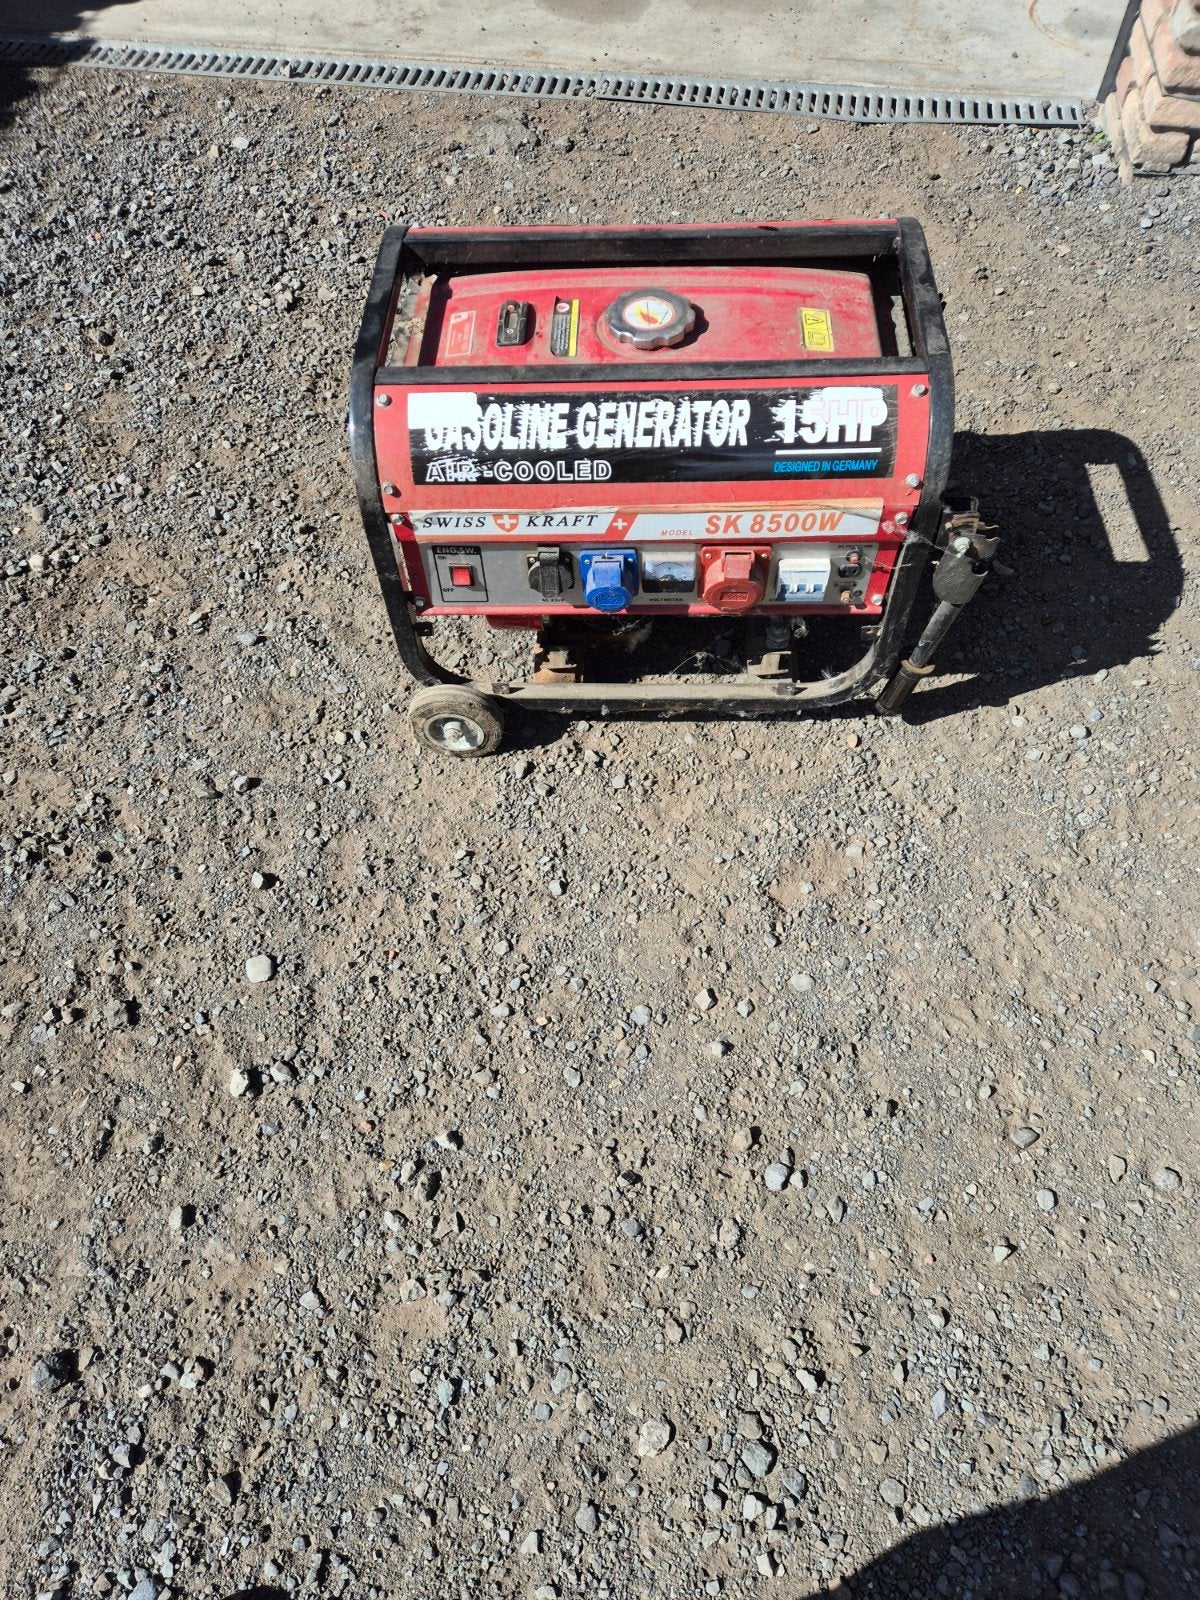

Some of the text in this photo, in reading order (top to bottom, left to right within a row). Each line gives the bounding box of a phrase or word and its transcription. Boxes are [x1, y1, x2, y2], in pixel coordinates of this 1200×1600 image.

[576, 399, 751, 449] GENERATOR
[780, 399, 888, 444] 15HP
[773, 459, 878, 473] DESIGNED IN GERMANY
[422, 514, 599, 528] SWISS KRAFT
[705, 514, 743, 535] SK
[749, 512, 845, 533] 8500W
